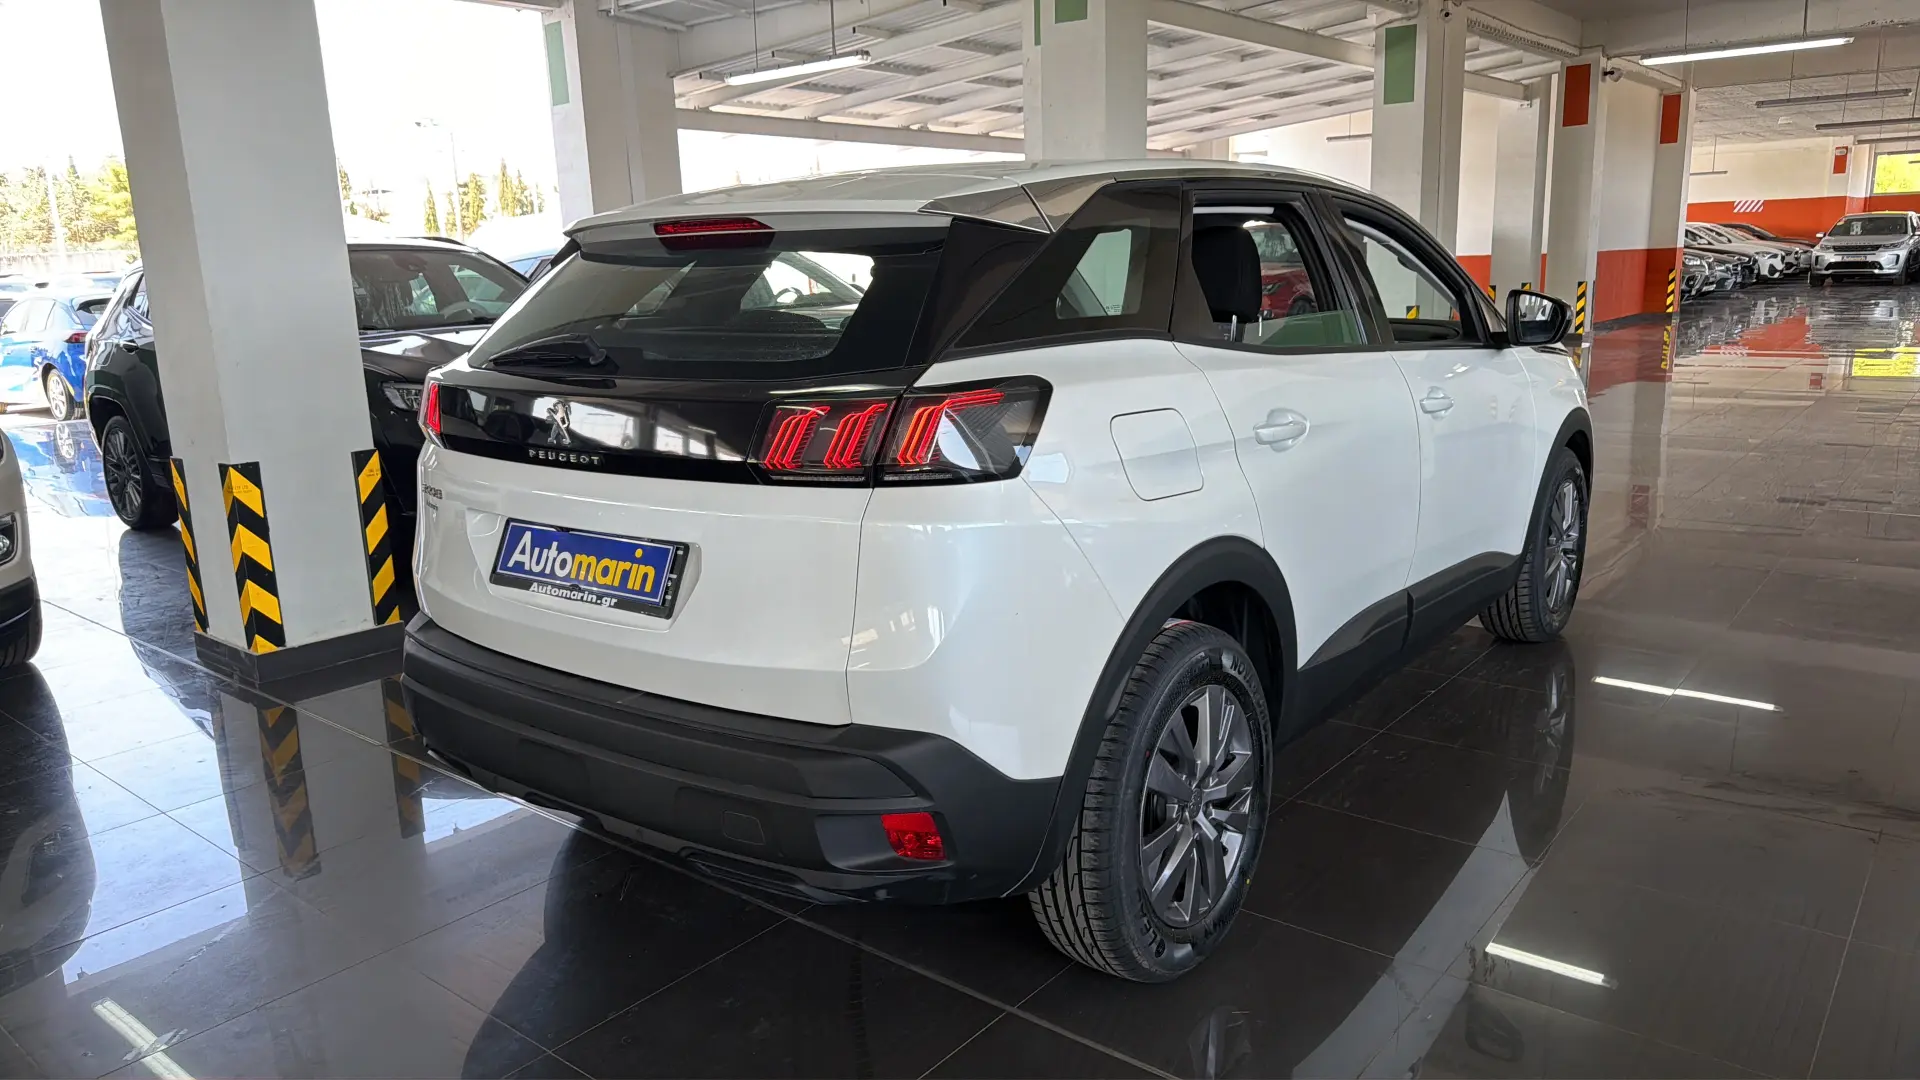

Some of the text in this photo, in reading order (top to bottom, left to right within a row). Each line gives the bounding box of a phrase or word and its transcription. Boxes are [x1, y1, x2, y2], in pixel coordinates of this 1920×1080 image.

[528, 449, 600, 465] PEUGEOT
[507, 530, 656, 593] Automarin
[529, 582, 617, 607] Automarin.gr
